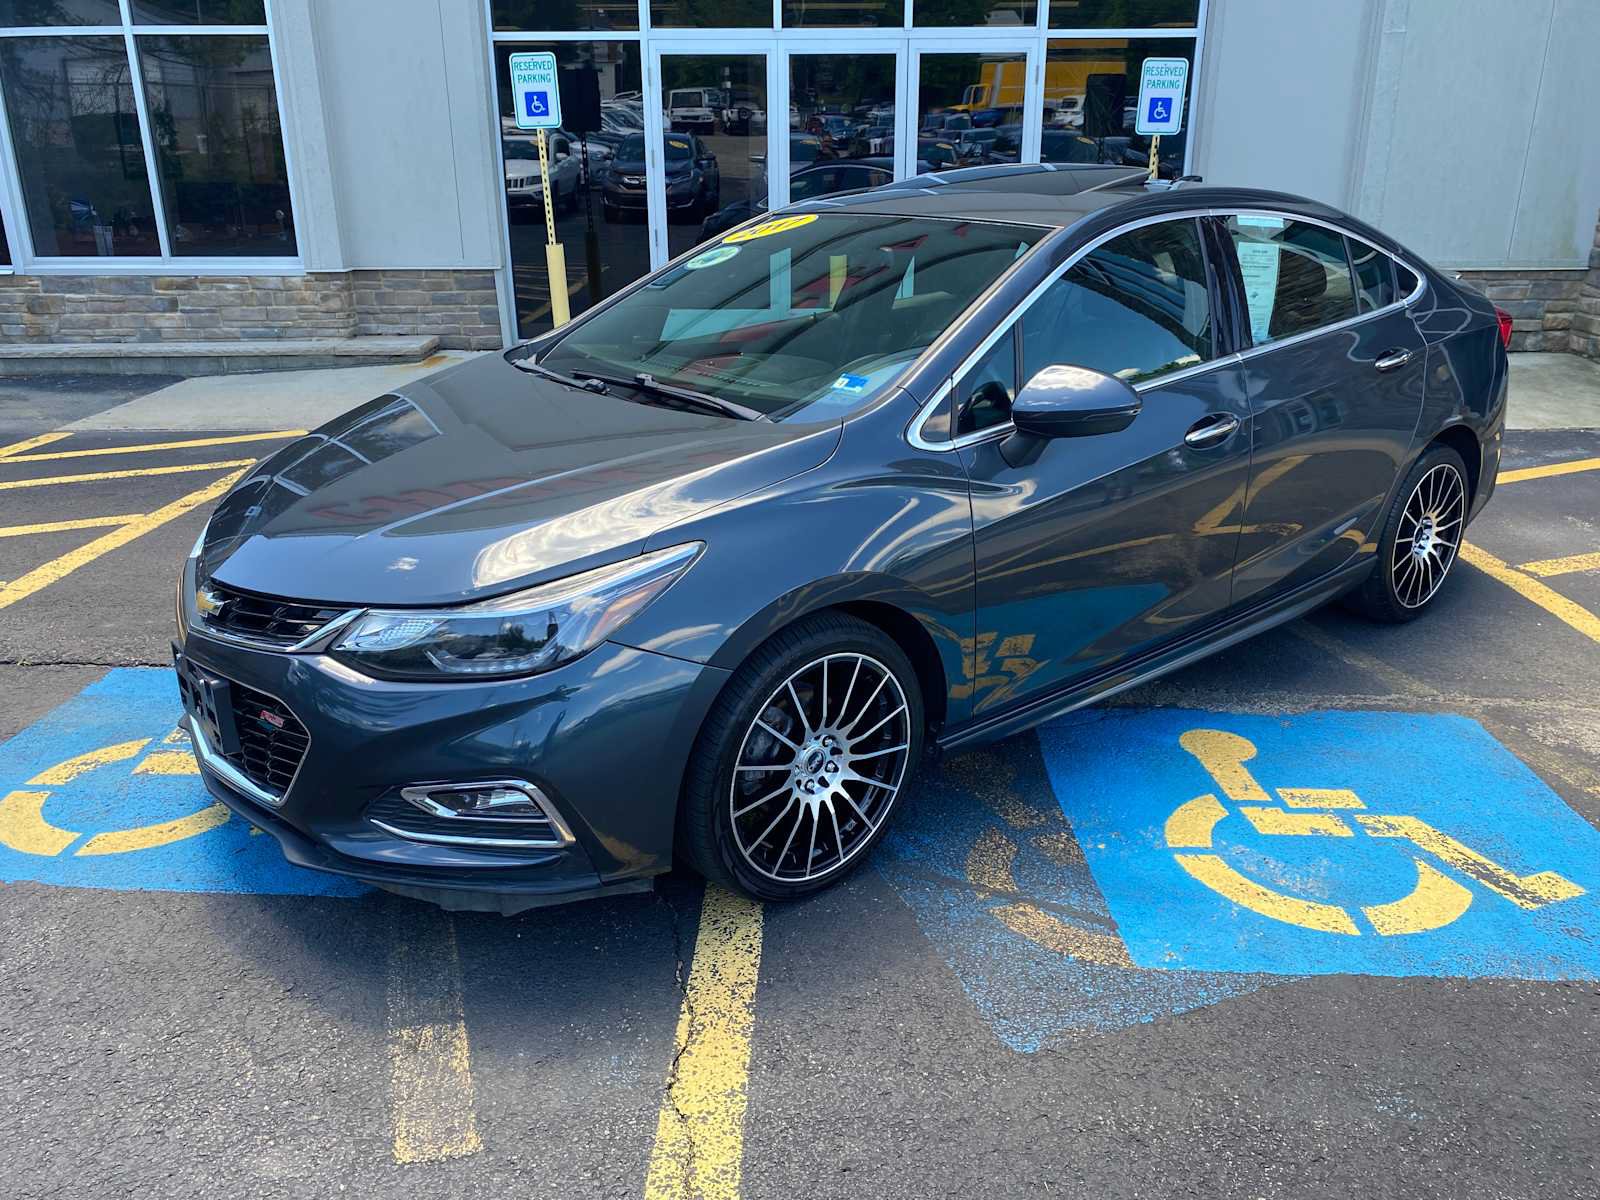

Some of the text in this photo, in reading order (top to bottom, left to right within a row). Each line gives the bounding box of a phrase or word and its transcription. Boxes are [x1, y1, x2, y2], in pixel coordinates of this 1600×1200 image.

[513, 61, 553, 71] RESERVED
[1145, 66, 1184, 76] RESERVED
[517, 74, 552, 83] PARKING
[1146, 79, 1181, 89] PARKING
